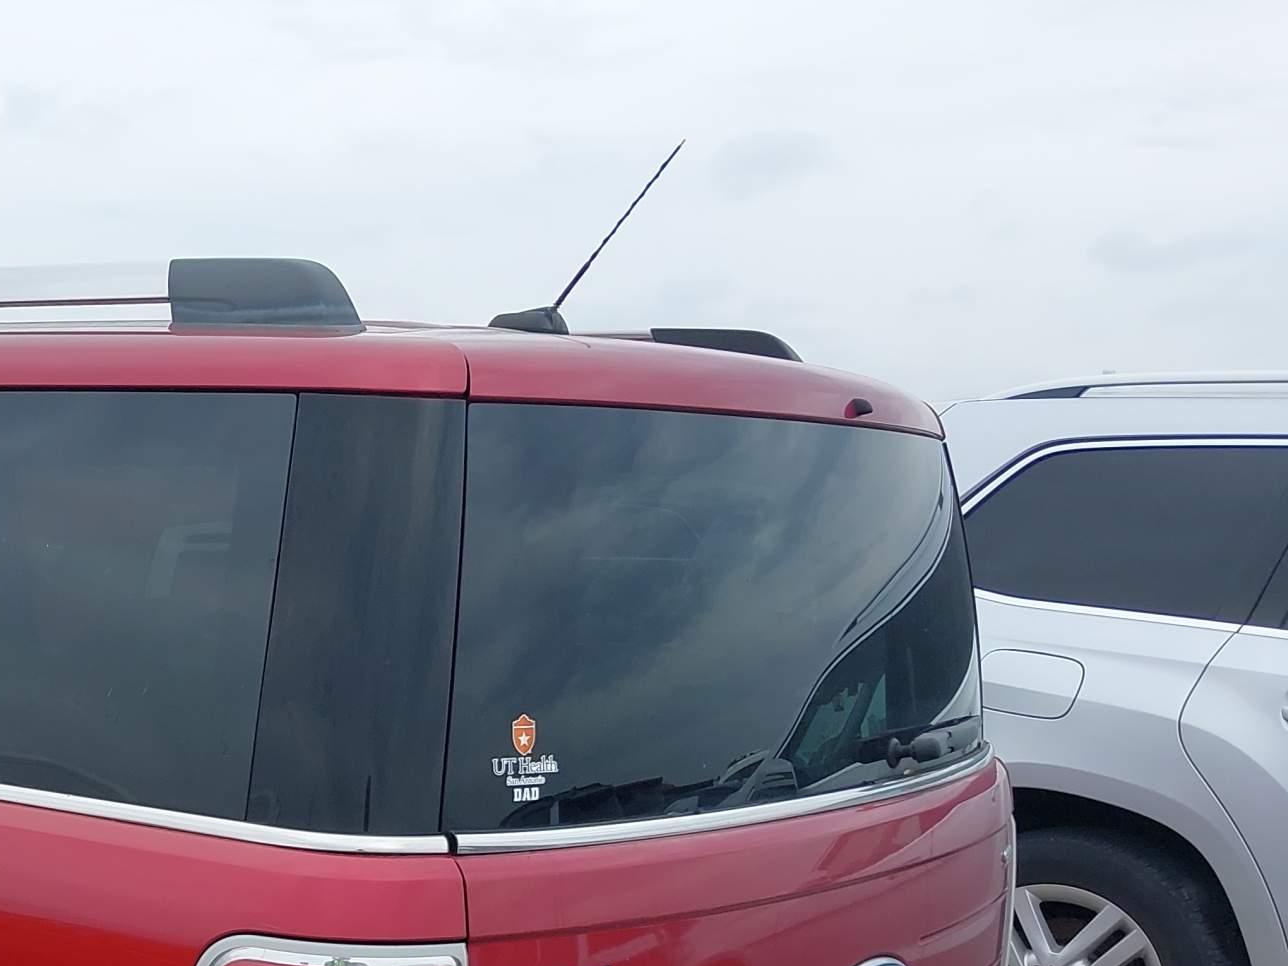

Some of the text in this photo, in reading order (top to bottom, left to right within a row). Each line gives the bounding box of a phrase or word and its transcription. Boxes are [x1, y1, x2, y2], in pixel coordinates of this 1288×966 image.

[492, 755, 559, 776] UT Health
[506, 776, 520, 786] San
[513, 787, 540, 802] DAD
